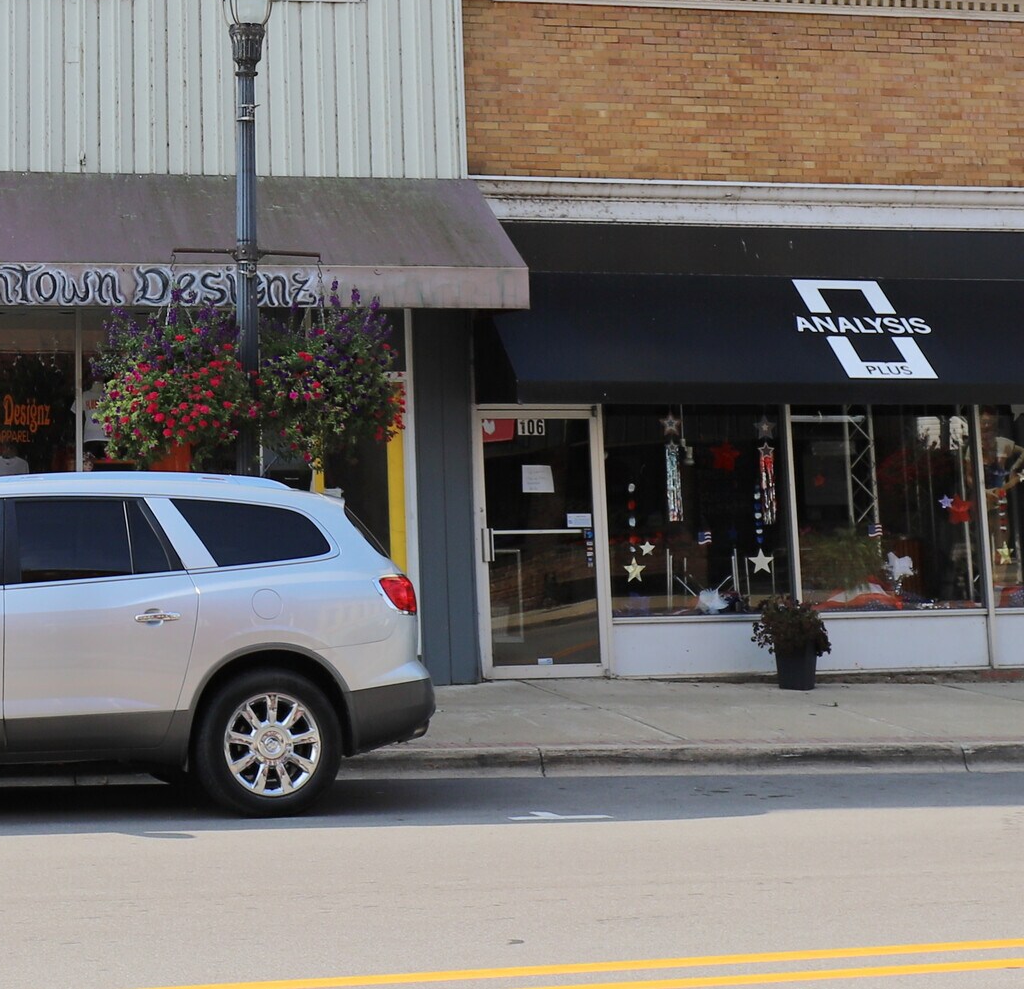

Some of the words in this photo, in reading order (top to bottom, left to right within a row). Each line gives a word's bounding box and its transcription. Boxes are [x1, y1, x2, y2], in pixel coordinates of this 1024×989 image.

[134, 264, 323, 307] Desinz
[796, 315, 932, 334] ANALYSIS
[866, 365, 913, 375] PLUS
[3, 394, 51, 433] Designz
[519, 419, 544, 435] 106
